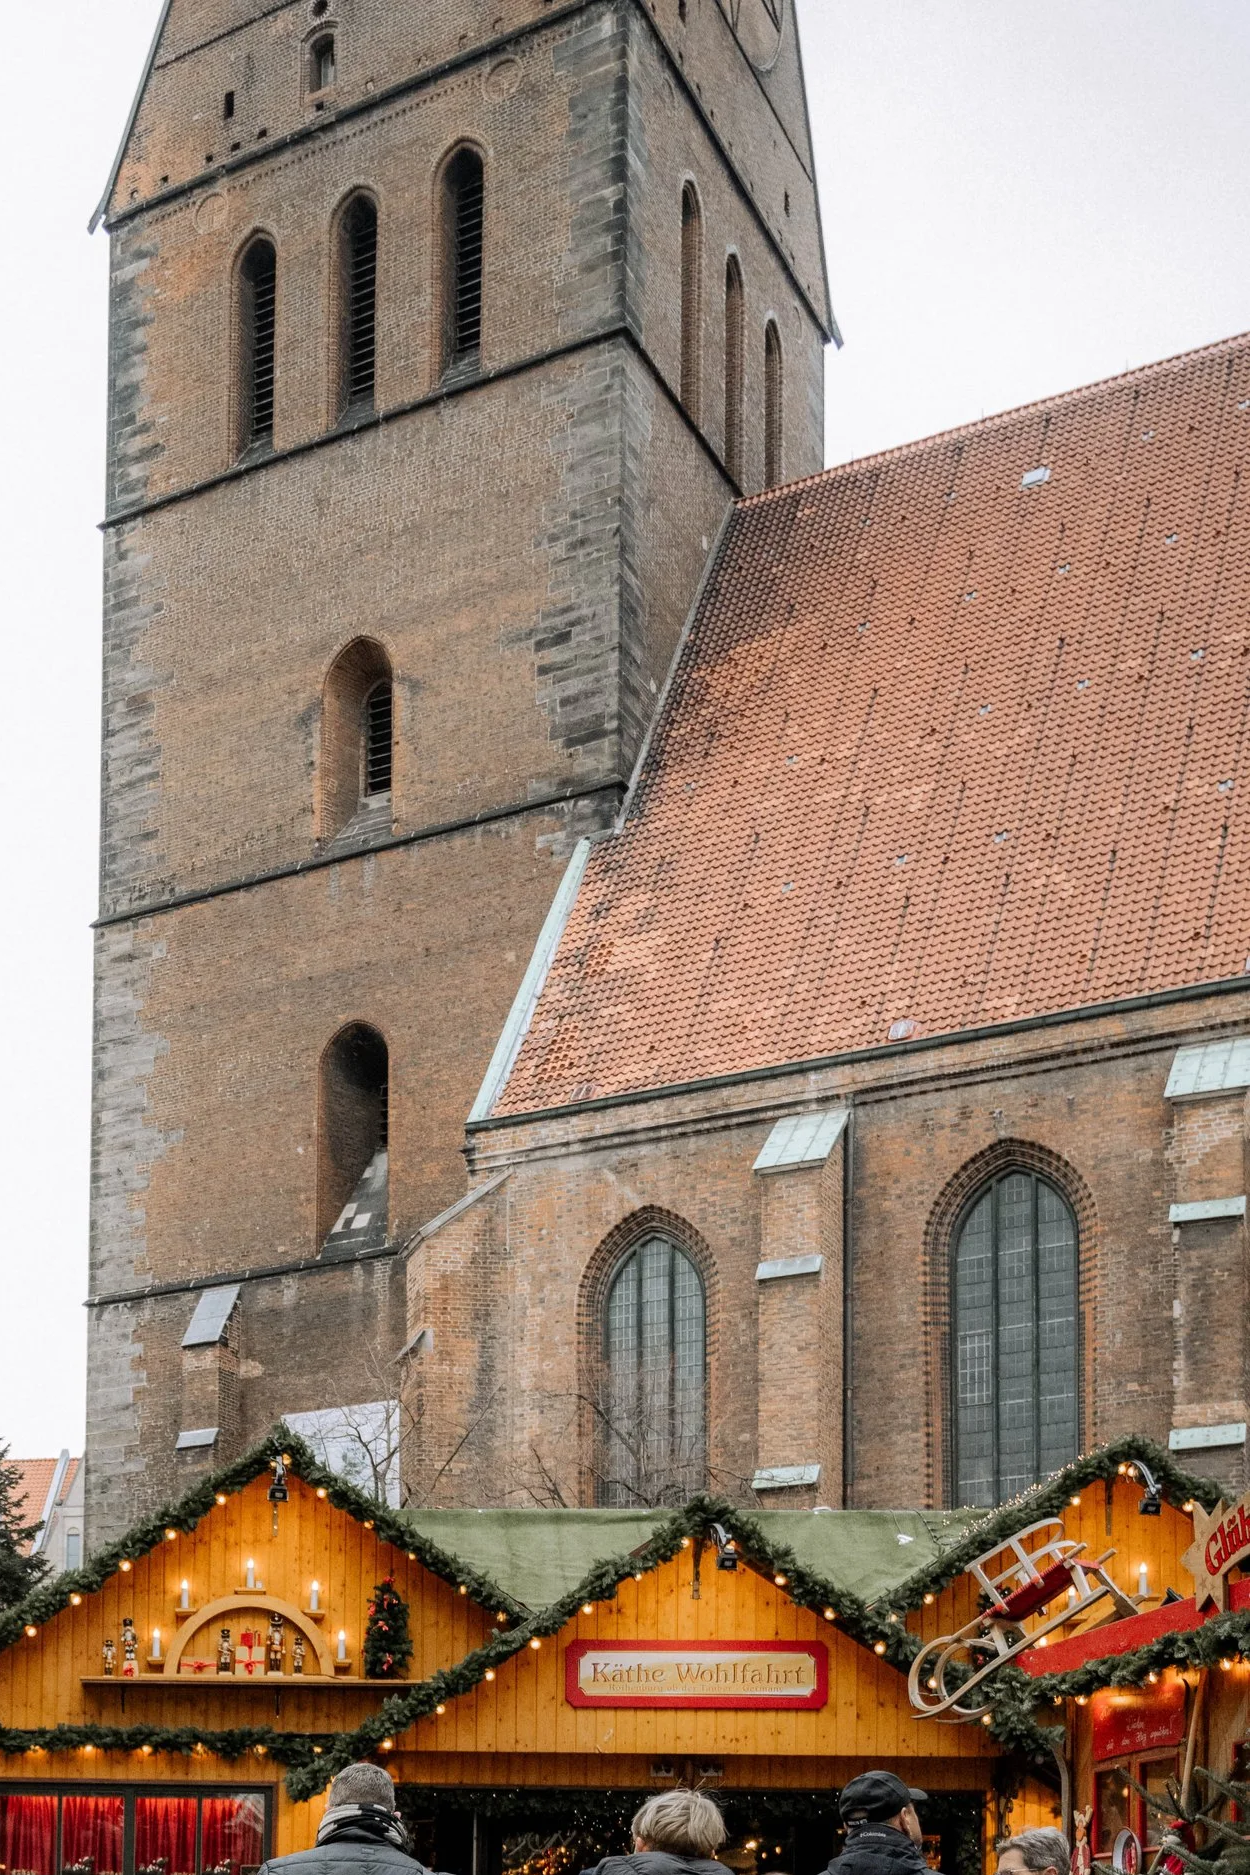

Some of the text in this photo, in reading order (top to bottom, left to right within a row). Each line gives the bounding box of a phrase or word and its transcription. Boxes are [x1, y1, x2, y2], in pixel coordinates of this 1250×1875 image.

[592, 1662, 805, 1684] Käthe Wohlfahrt
[609, 1684, 663, 1693] Rothenburg
[667, 1684, 679, 1692] ob
[681, 1684, 696, 1692] der
[742, 1685, 783, 1693] Germany
